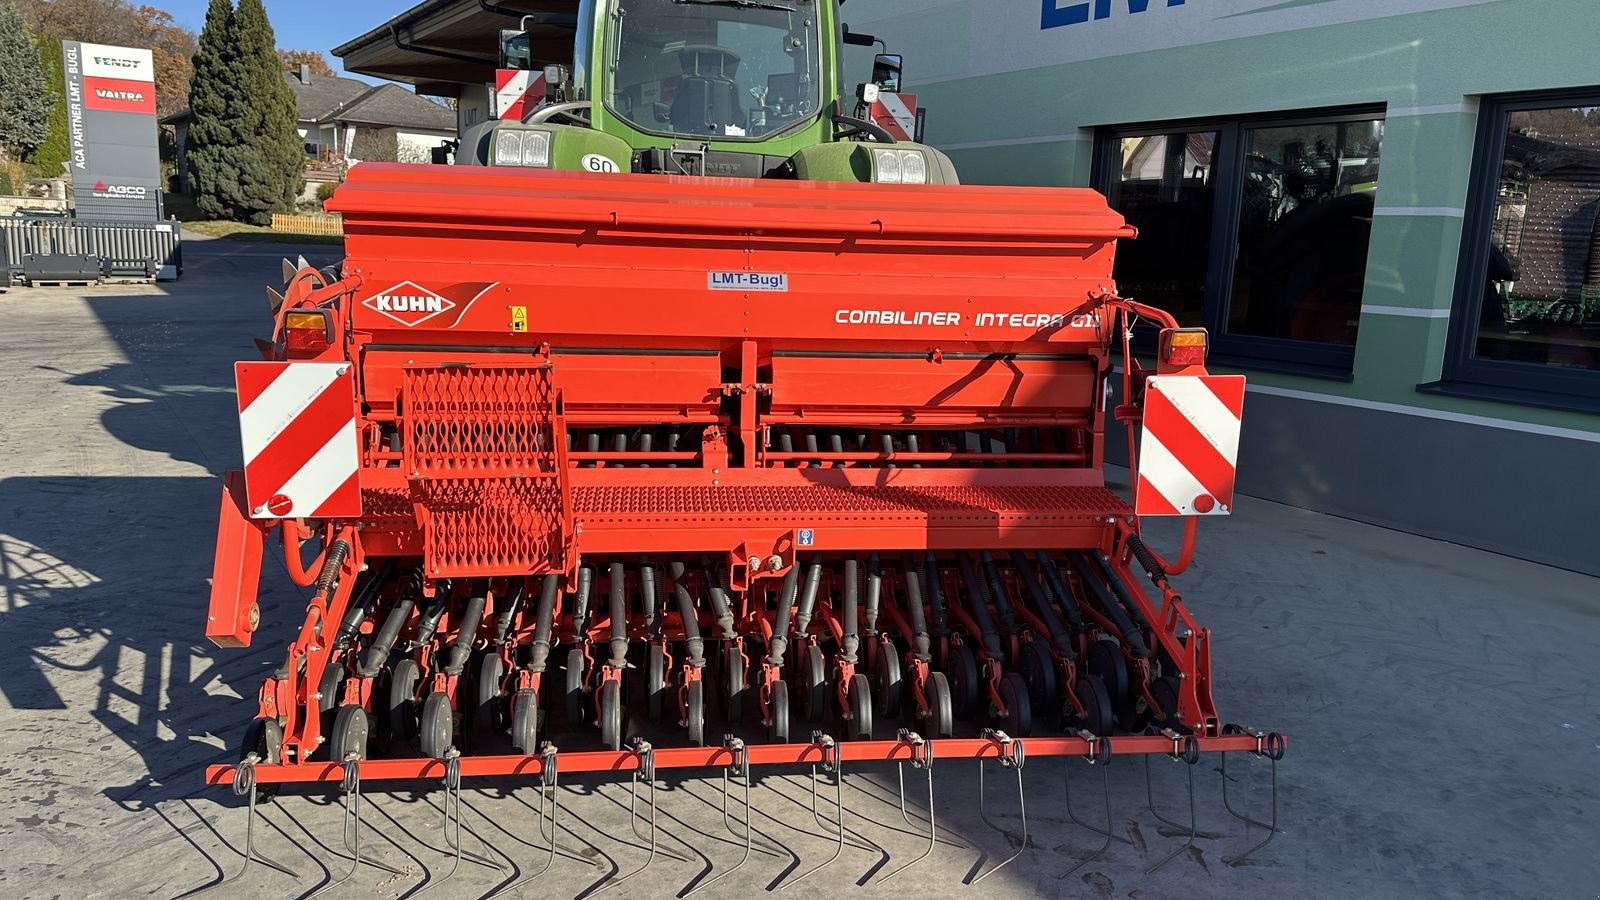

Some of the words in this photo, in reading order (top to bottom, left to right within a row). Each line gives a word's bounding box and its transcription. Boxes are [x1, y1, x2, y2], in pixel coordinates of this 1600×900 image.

[67, 46, 79, 74] BUGL
[93, 56, 142, 68] FENDT
[69, 80, 81, 102] LMT
[95, 88, 145, 102] VALTRA
[71, 103, 84, 147] PARTNER
[75, 149, 86, 169] ACA
[589, 156, 613, 173] 60
[107, 185, 146, 195] AGCO
[712, 272, 783, 287] LMT-Bugl
[376, 295, 442, 312] KUHN
[835, 309, 961, 326] COMBILINER
[975, 313, 1064, 328] INTEGRA
